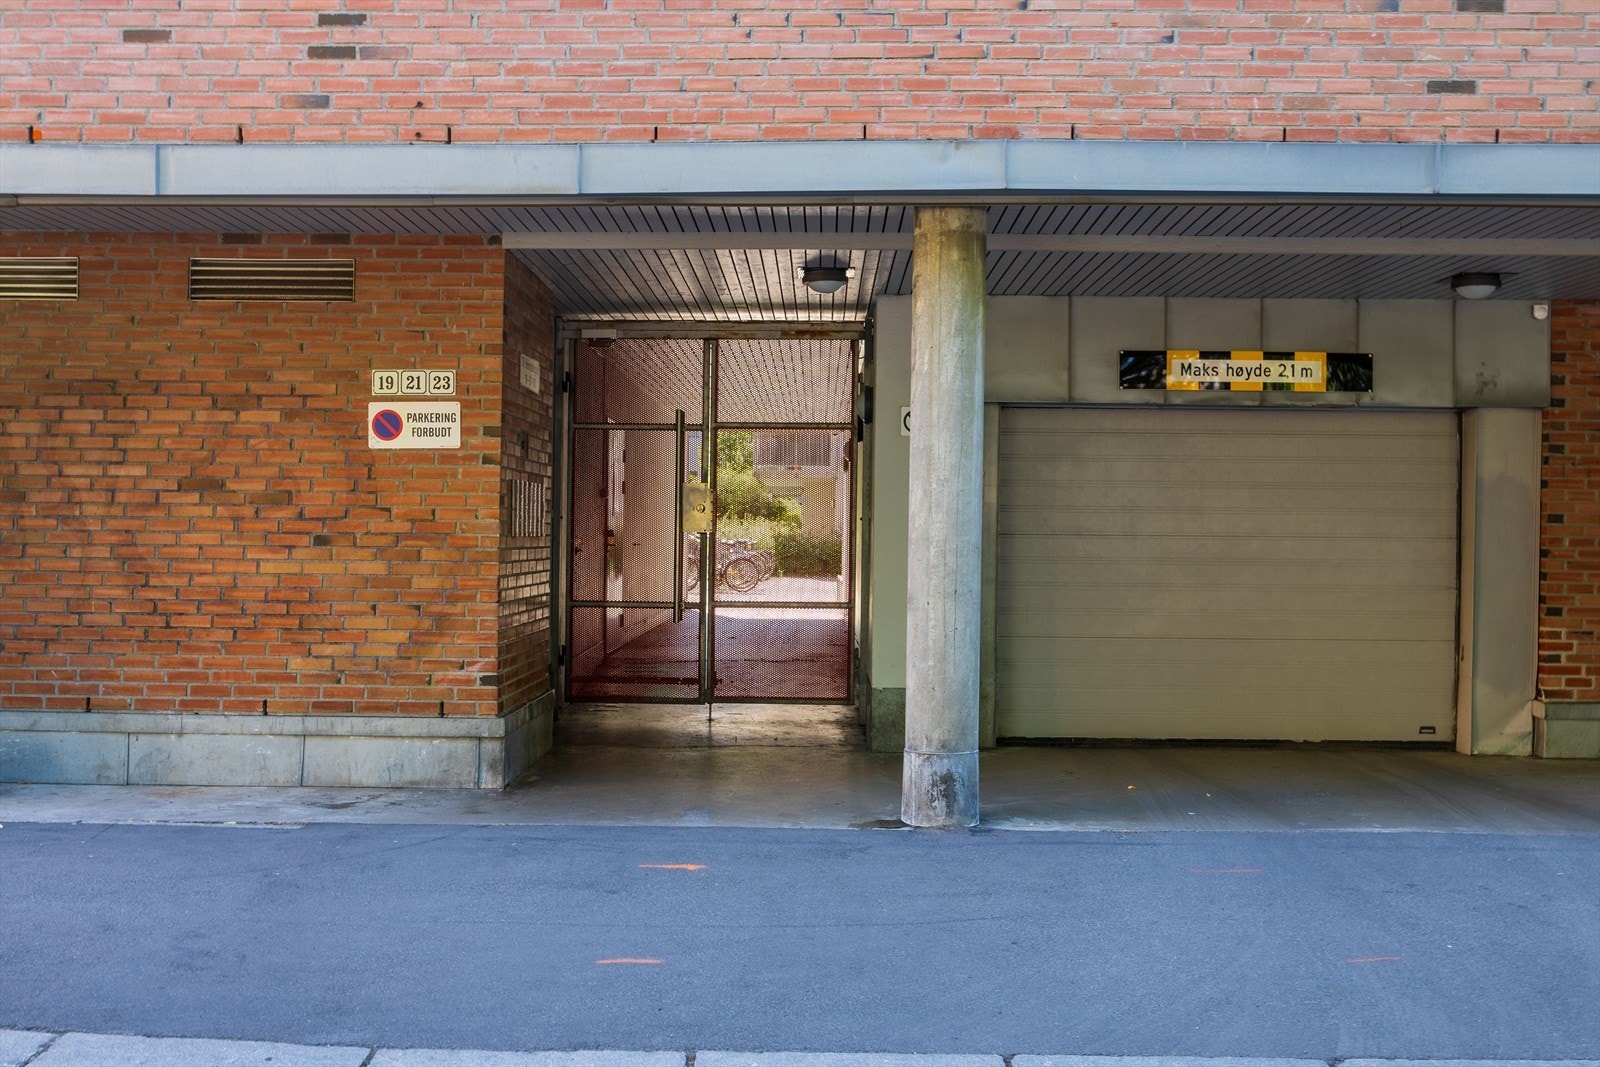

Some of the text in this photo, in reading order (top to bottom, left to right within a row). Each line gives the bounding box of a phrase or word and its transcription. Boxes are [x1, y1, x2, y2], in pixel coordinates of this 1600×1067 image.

[1180, 362, 1313, 381] Maks høyde 2,1 m
[378, 375, 451, 390] 19 21 23
[406, 412, 457, 423] PARKERING
[411, 427, 452, 438] FORBUDT
